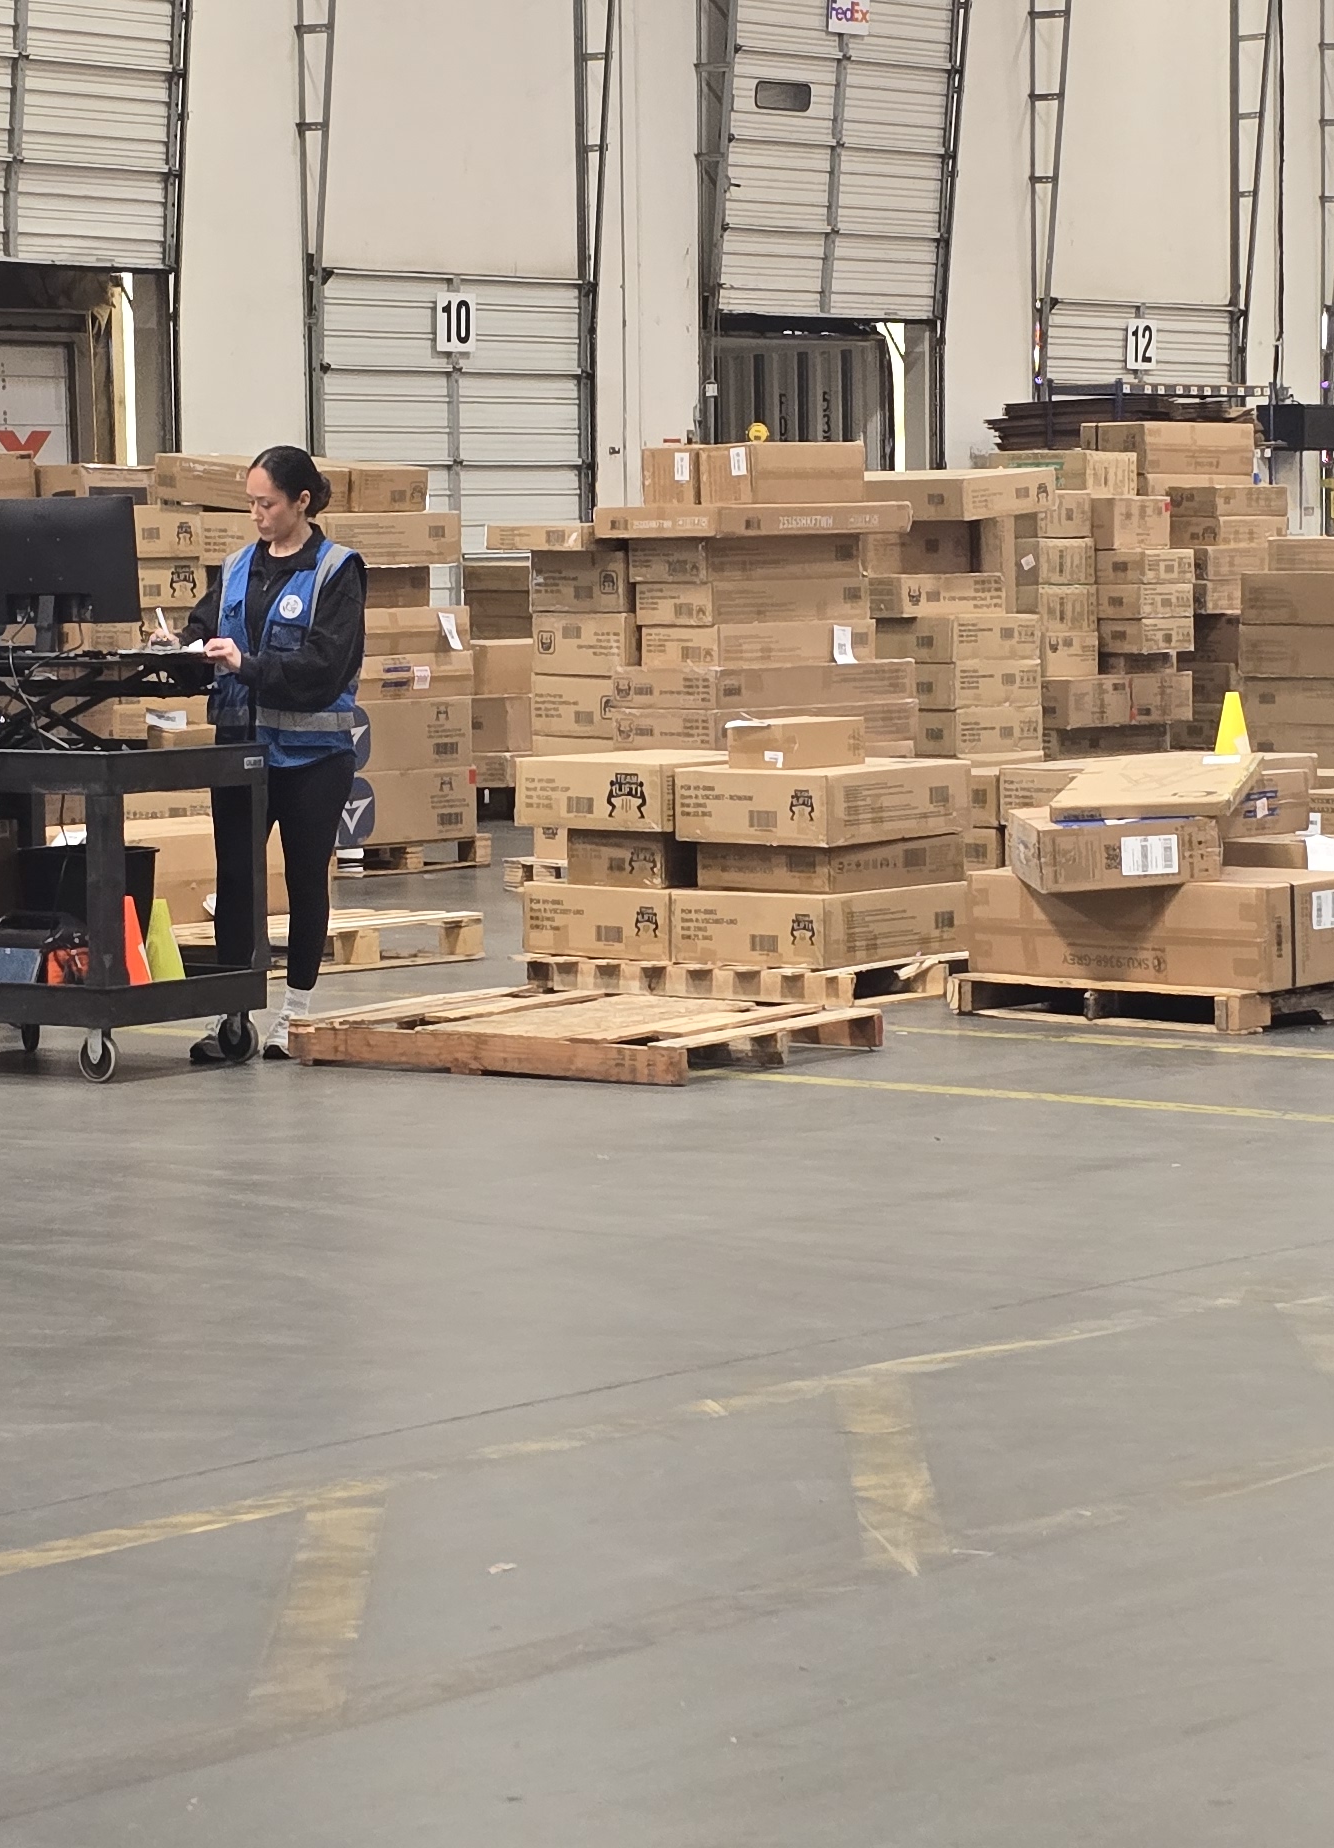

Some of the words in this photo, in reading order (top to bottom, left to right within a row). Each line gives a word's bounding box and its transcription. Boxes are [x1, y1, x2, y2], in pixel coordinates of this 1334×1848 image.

[830, 0, 869, 23] FedEx
[442, 299, 470, 345] 10
[1131, 324, 1153, 365] 12
[616, 774, 638, 783] TEAM
